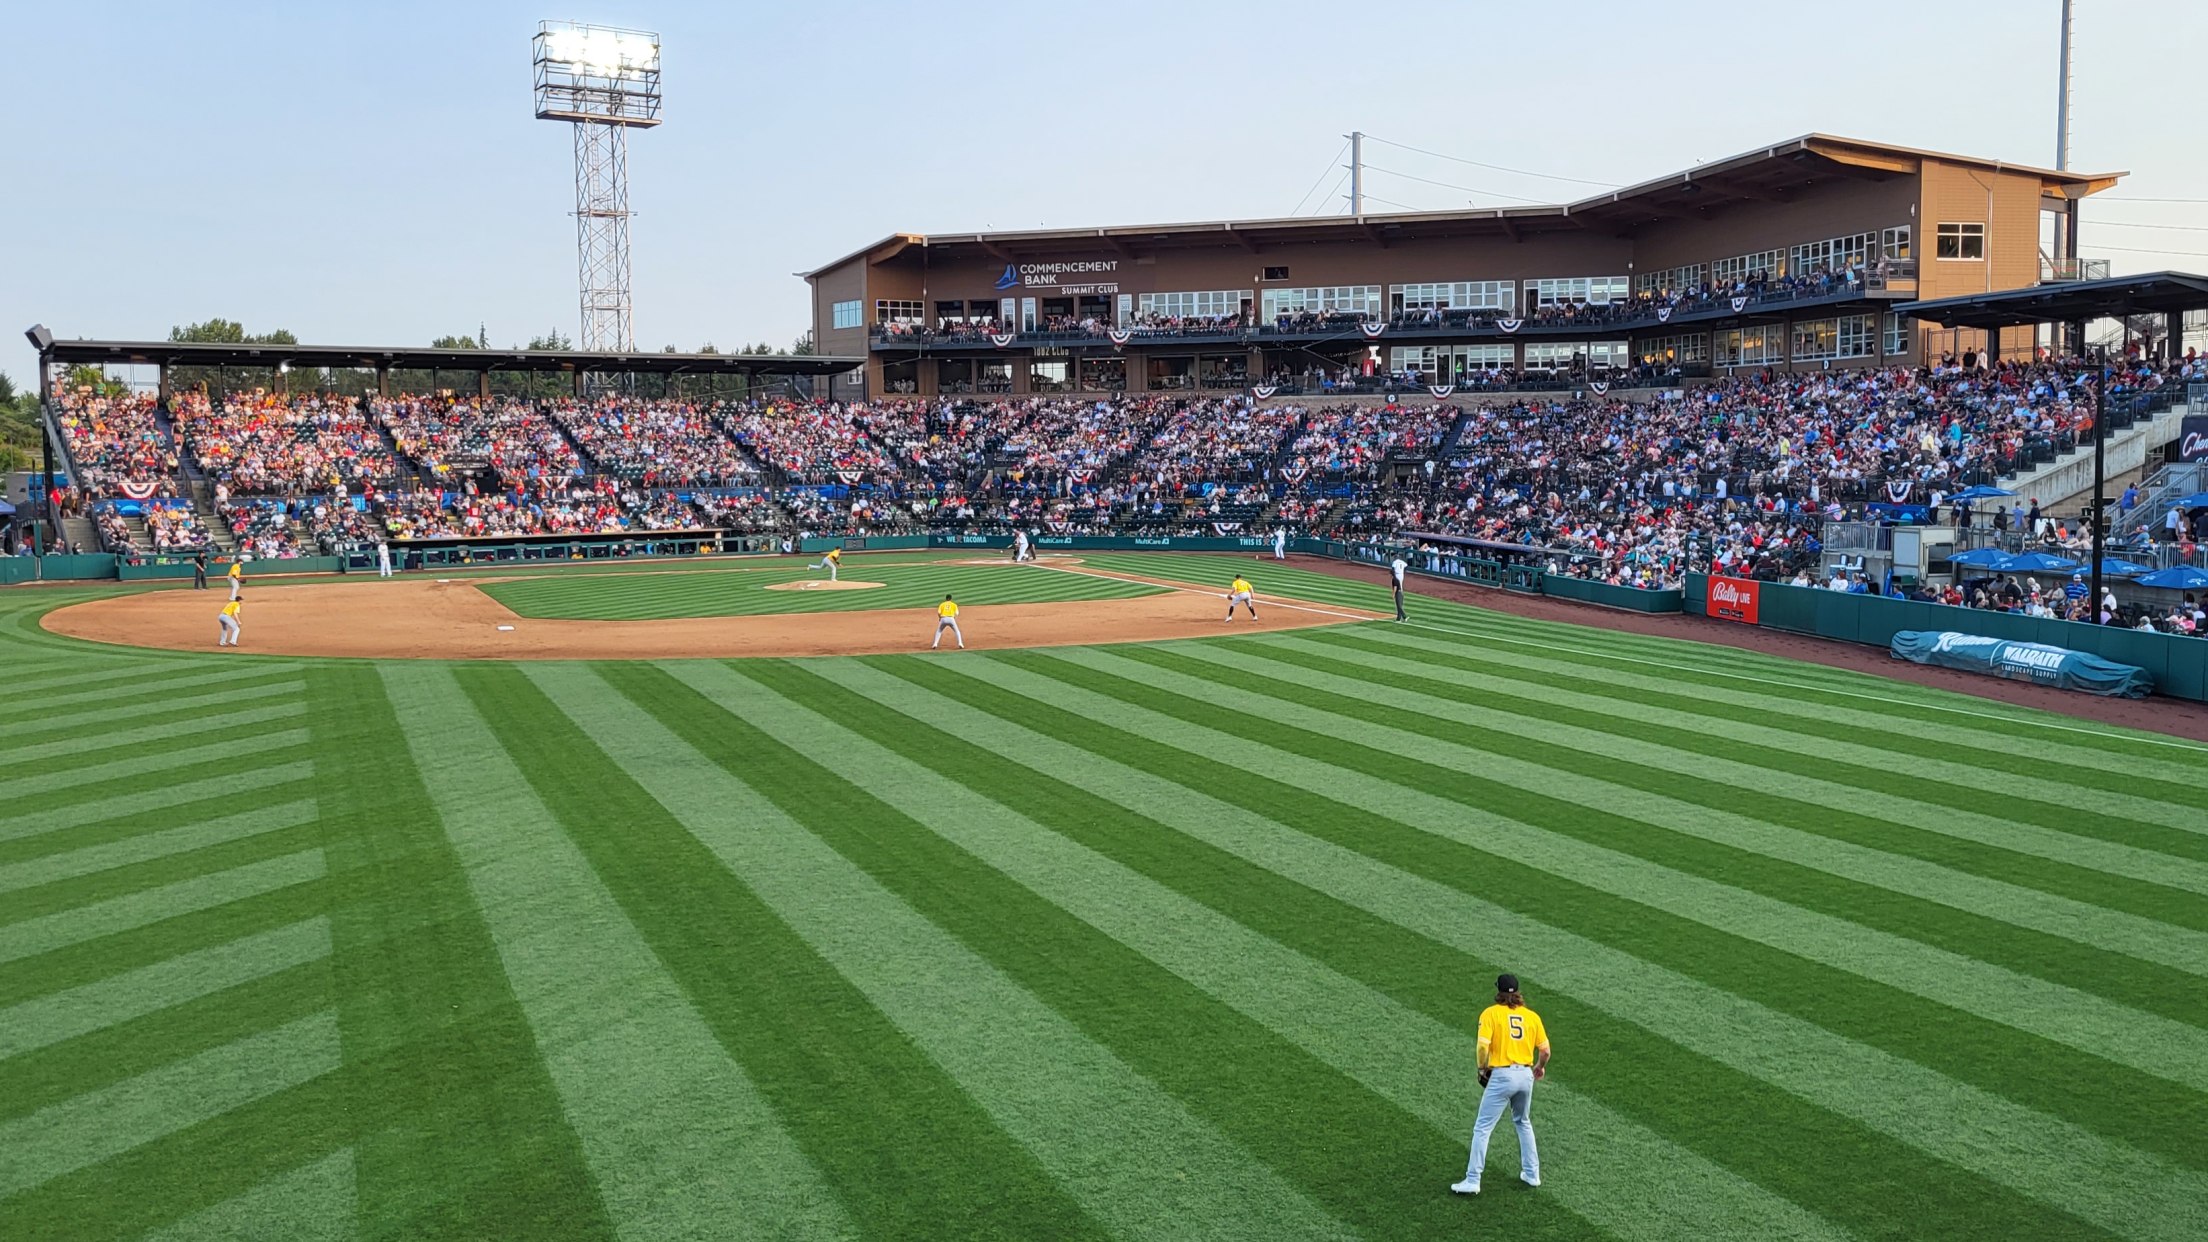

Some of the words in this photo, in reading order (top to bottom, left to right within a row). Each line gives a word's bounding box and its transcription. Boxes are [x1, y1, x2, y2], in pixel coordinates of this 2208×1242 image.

[1020, 261, 1118, 274] COMMENCEMENT
[1025, 274, 1057, 285] BANK
[1061, 286, 1095, 295] SUMMIT
[1098, 285, 1119, 293] CLUB
[1115, 392, 1121, 400] J
[1246, 396, 1254, 405] H
[1388, 394, 1396, 403] G
[1576, 391, 1582, 400] F
[946, 535, 956, 543] WE
[963, 535, 987, 543] TACOMA
[1240, 538, 1255, 546] THIS
[1256, 538, 1262, 546] IS
[1712, 581, 1739, 608] Bally
[1740, 592, 1751, 604] LIVE
[2002, 646, 2067, 668] WALRATH
[2001, 664, 2033, 676] LANDSCAPE
[2035, 669, 2057, 679] SUPPLY
[1509, 1014, 1523, 1040] 5
